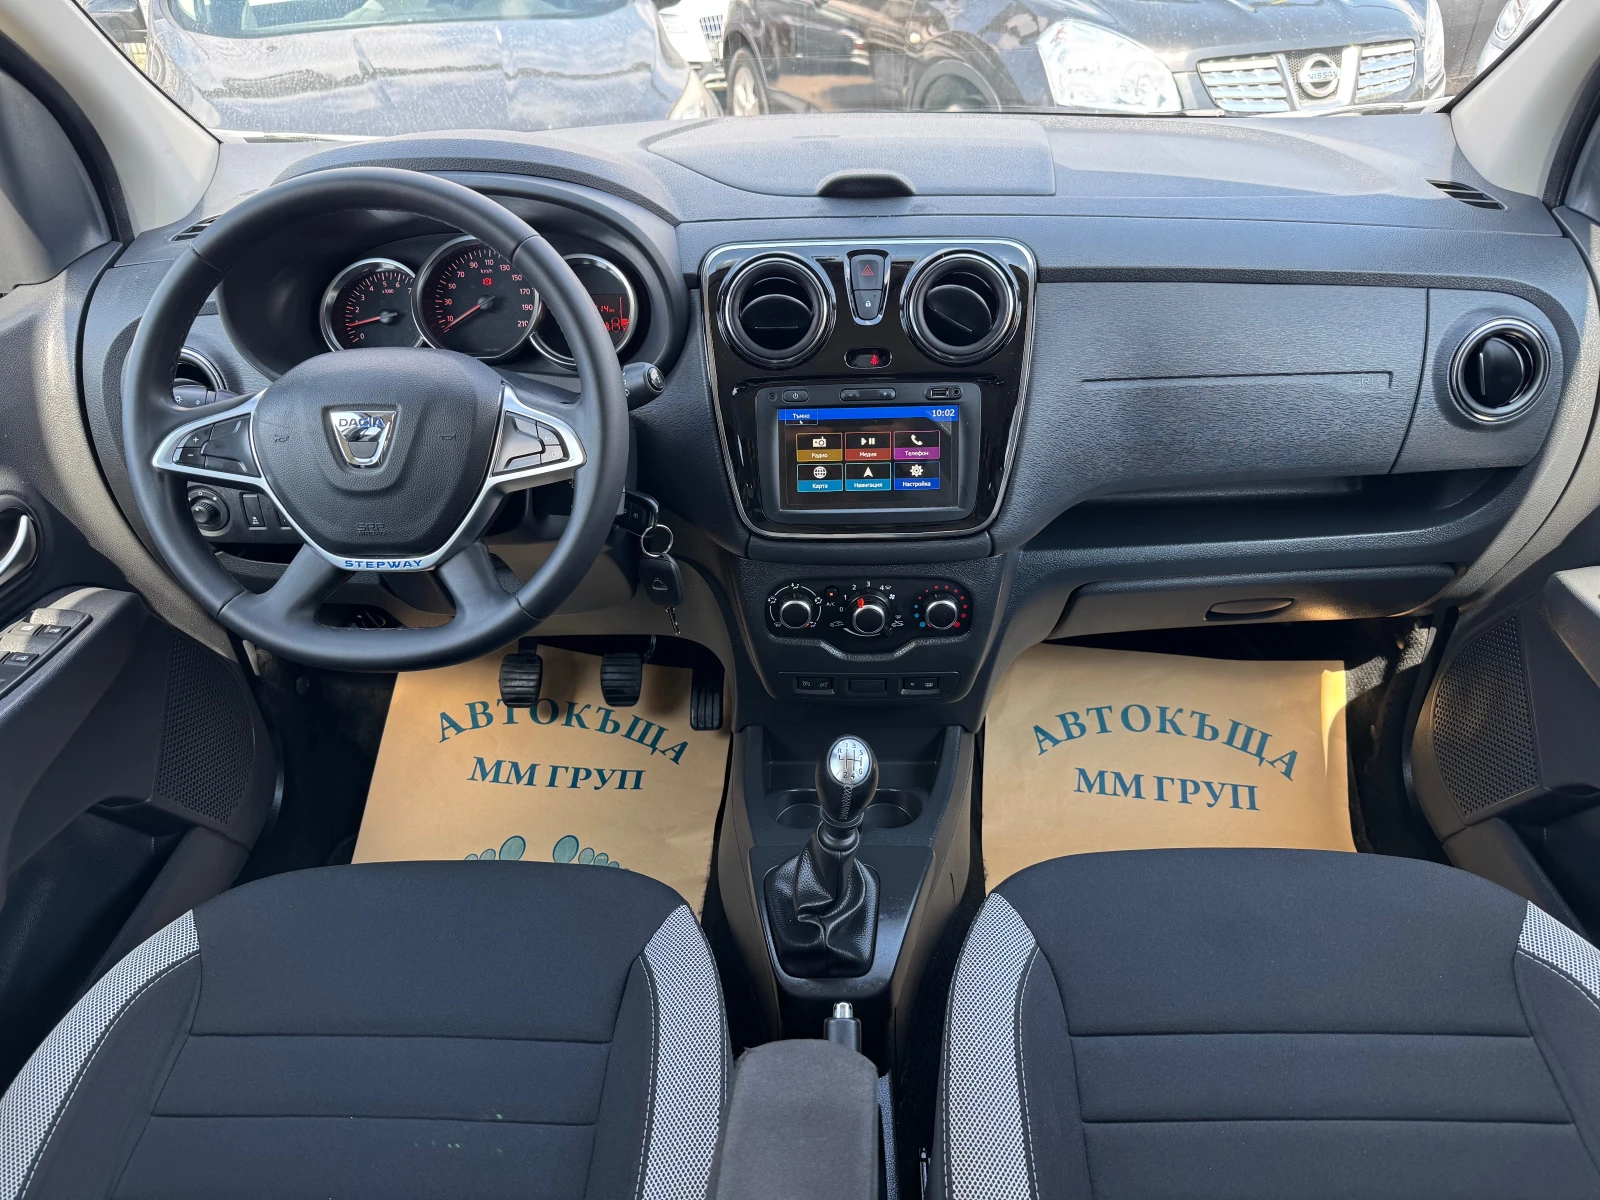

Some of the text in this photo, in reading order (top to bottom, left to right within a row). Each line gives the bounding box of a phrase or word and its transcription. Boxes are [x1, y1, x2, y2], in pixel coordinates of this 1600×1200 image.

[1308, 71, 1337, 79] NISSAN
[339, 416, 385, 428] DACIA
[932, 409, 955, 417] 10:02
[344, 559, 423, 569] STEPWAY
[439, 698, 689, 765] АВТОКЪЩА
[1033, 704, 1298, 781] АВТОКЪЩА
[467, 756, 646, 790] ММ ГРУП
[1073, 767, 1260, 811] ММ ГРУП
